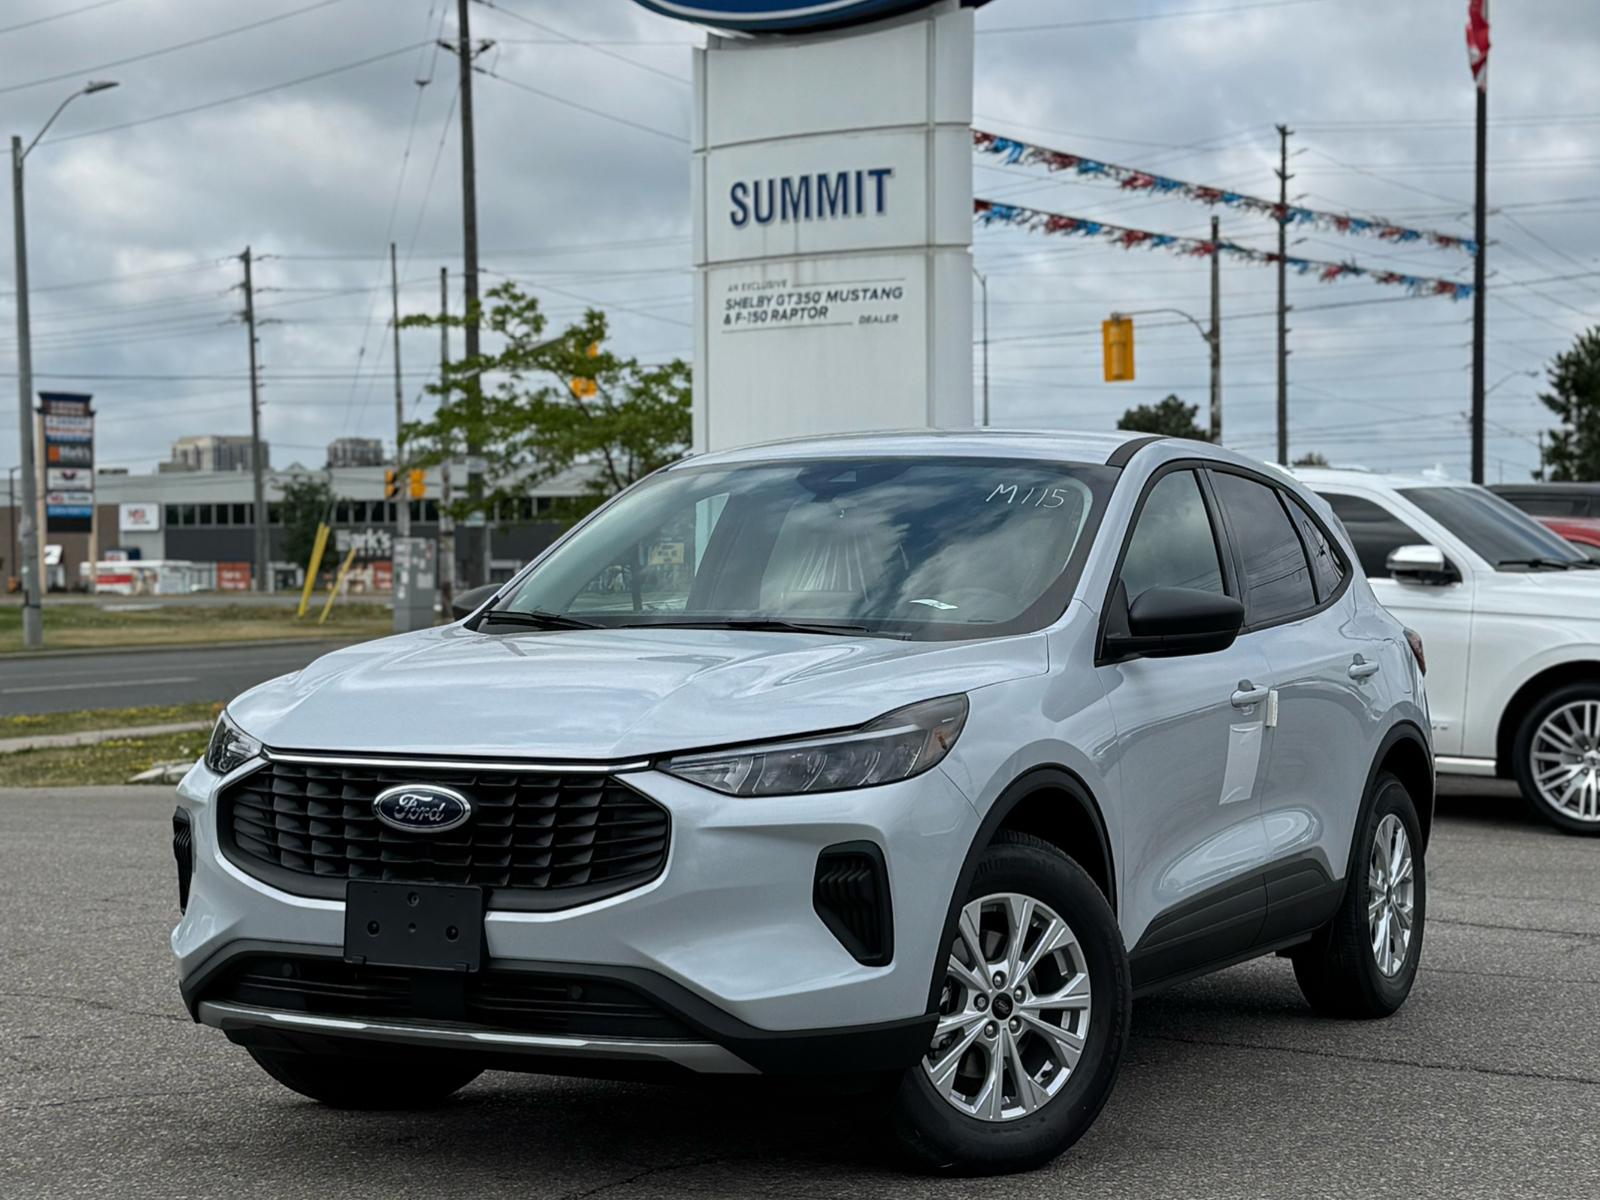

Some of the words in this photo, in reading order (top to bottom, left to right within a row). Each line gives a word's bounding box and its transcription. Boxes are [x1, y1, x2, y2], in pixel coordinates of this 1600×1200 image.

[729, 168, 893, 227] SUMMIT
[725, 294, 773, 310] SHELBY
[776, 291, 821, 307] GT350
[826, 286, 903, 303] MUSTANG
[741, 280, 788, 292] EXCLUSIVE
[723, 313, 732, 325] &
[735, 310, 768, 325] F-150
[771, 306, 829, 322] RAPTOR
[858, 314, 899, 325] DEALER
[985, 483, 1068, 508] M115
[394, 794, 446, 822] Ford
